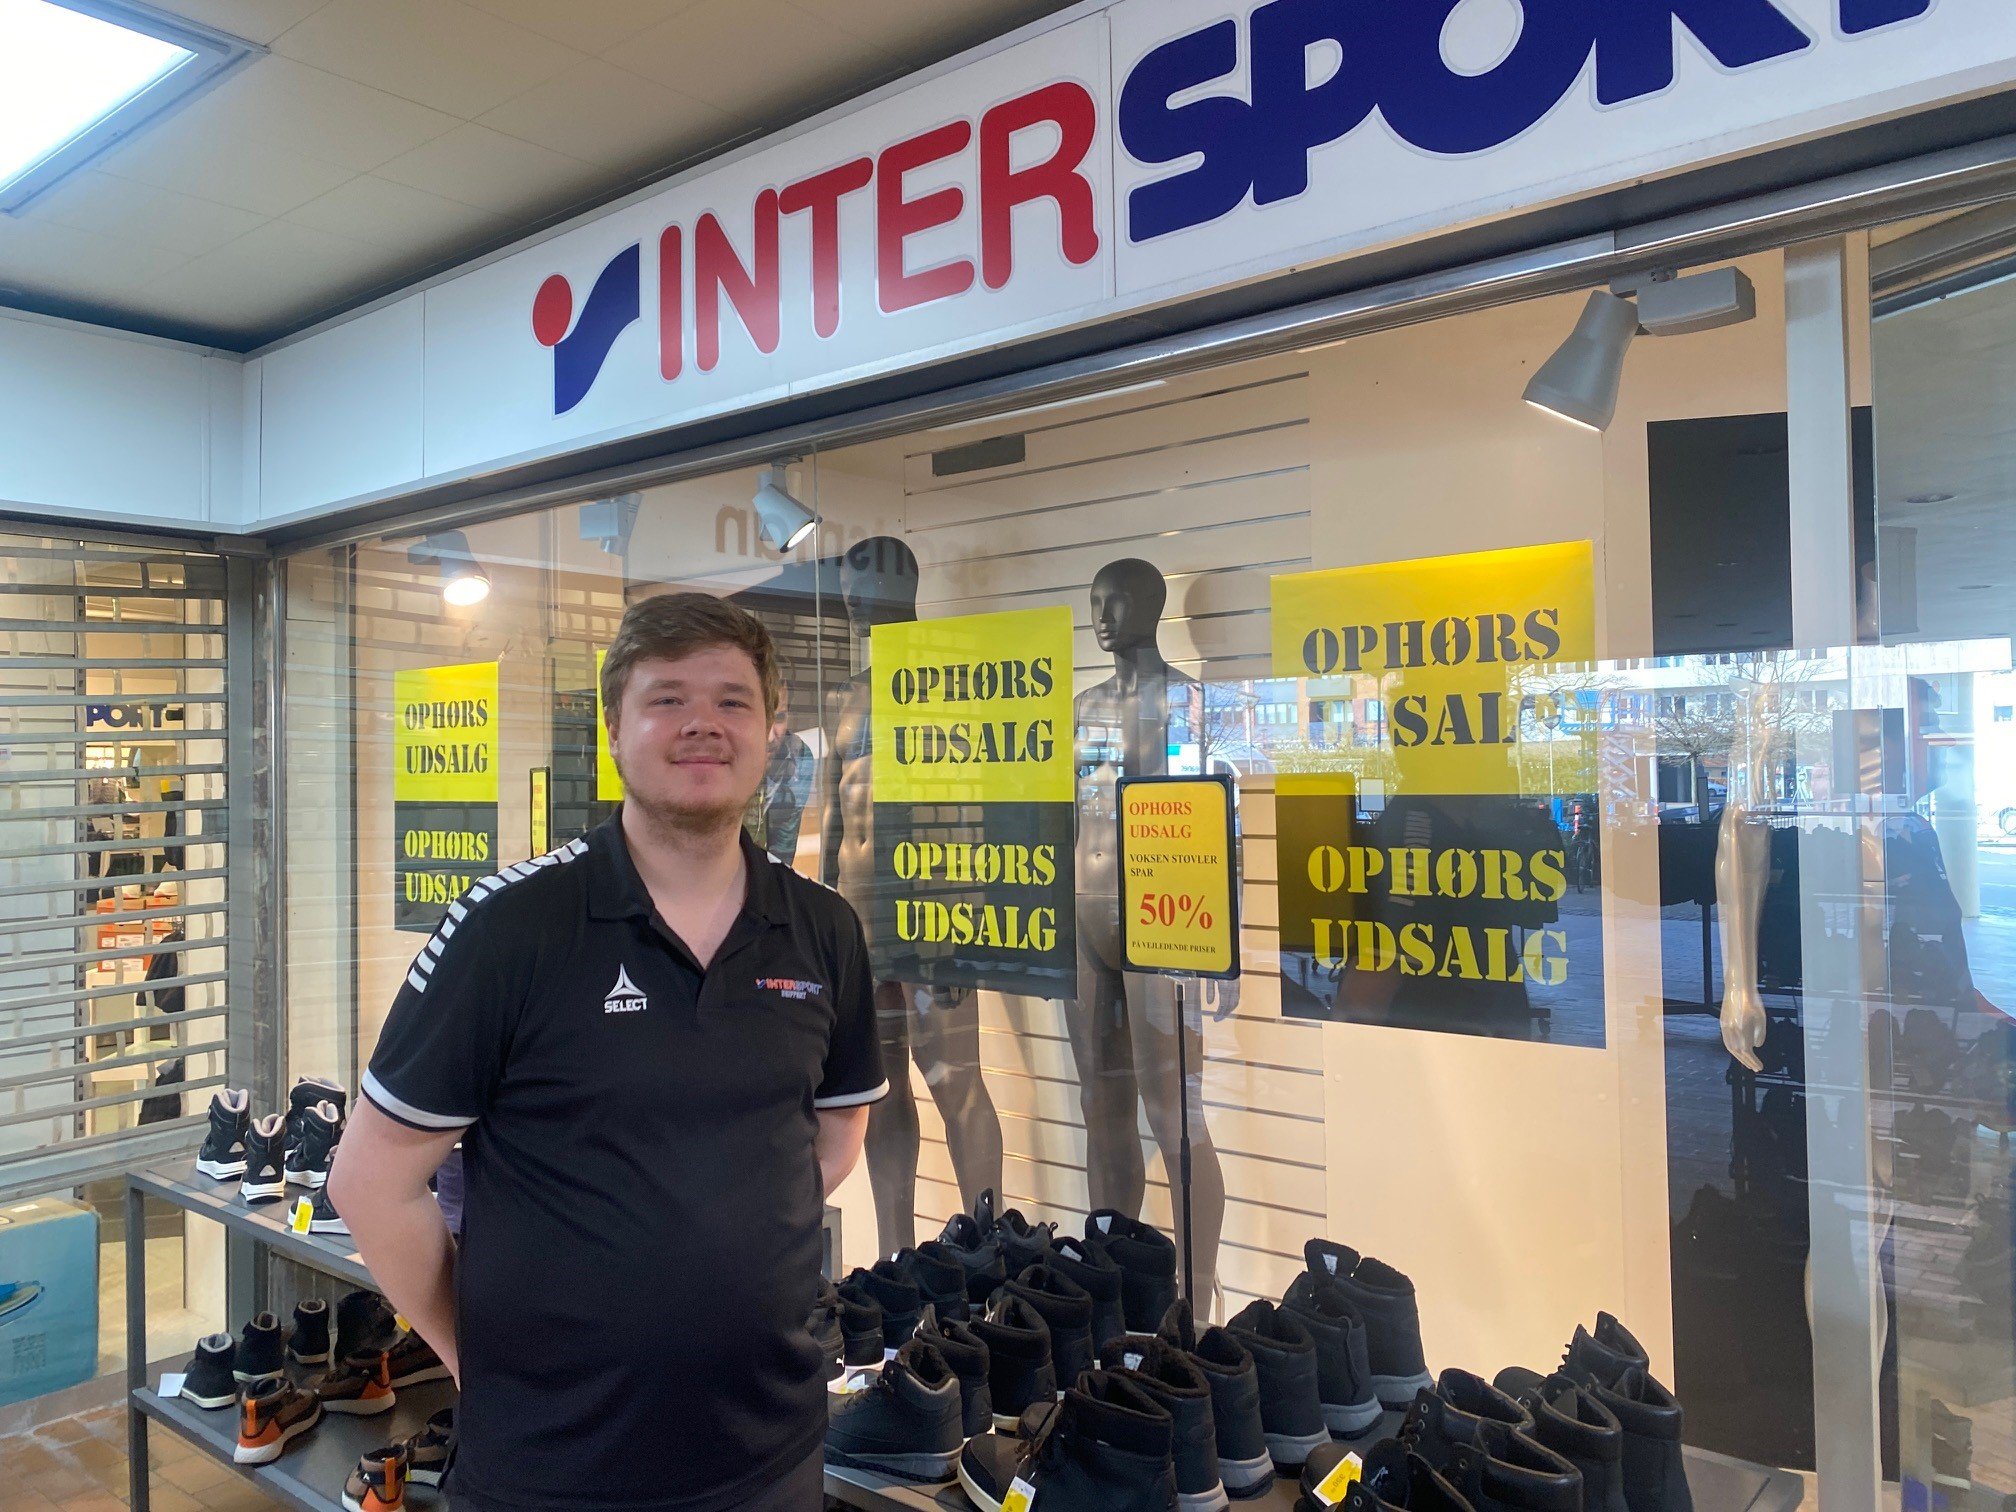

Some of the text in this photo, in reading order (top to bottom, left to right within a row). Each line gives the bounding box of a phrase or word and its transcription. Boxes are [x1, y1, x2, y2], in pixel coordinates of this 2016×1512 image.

[1302, 607, 1561, 674] OPHØRS
[891, 656, 1053, 705] OPHØRS
[404, 698, 488, 730] OPHØRS
[405, 743, 488, 774] UDSALG
[893, 719, 1054, 765] UDSALG
[1129, 801, 1192, 815] OPHØRS
[404, 830, 489, 861] OPHØRS
[1130, 824, 1192, 839] UDSALG
[893, 841, 1056, 886] OPHØRS
[1130, 853, 1218, 864] VOKSEN STØVLER
[1130, 867, 1154, 877] SPAR
[1307, 845, 1568, 902] OPHØRS
[404, 871, 474, 904] UDSA
[895, 900, 1057, 951] UDSALG
[1139, 893, 1213, 930] 50%
[1310, 918, 1569, 986] UDSALG
[604, 997, 648, 1014] SELECT
